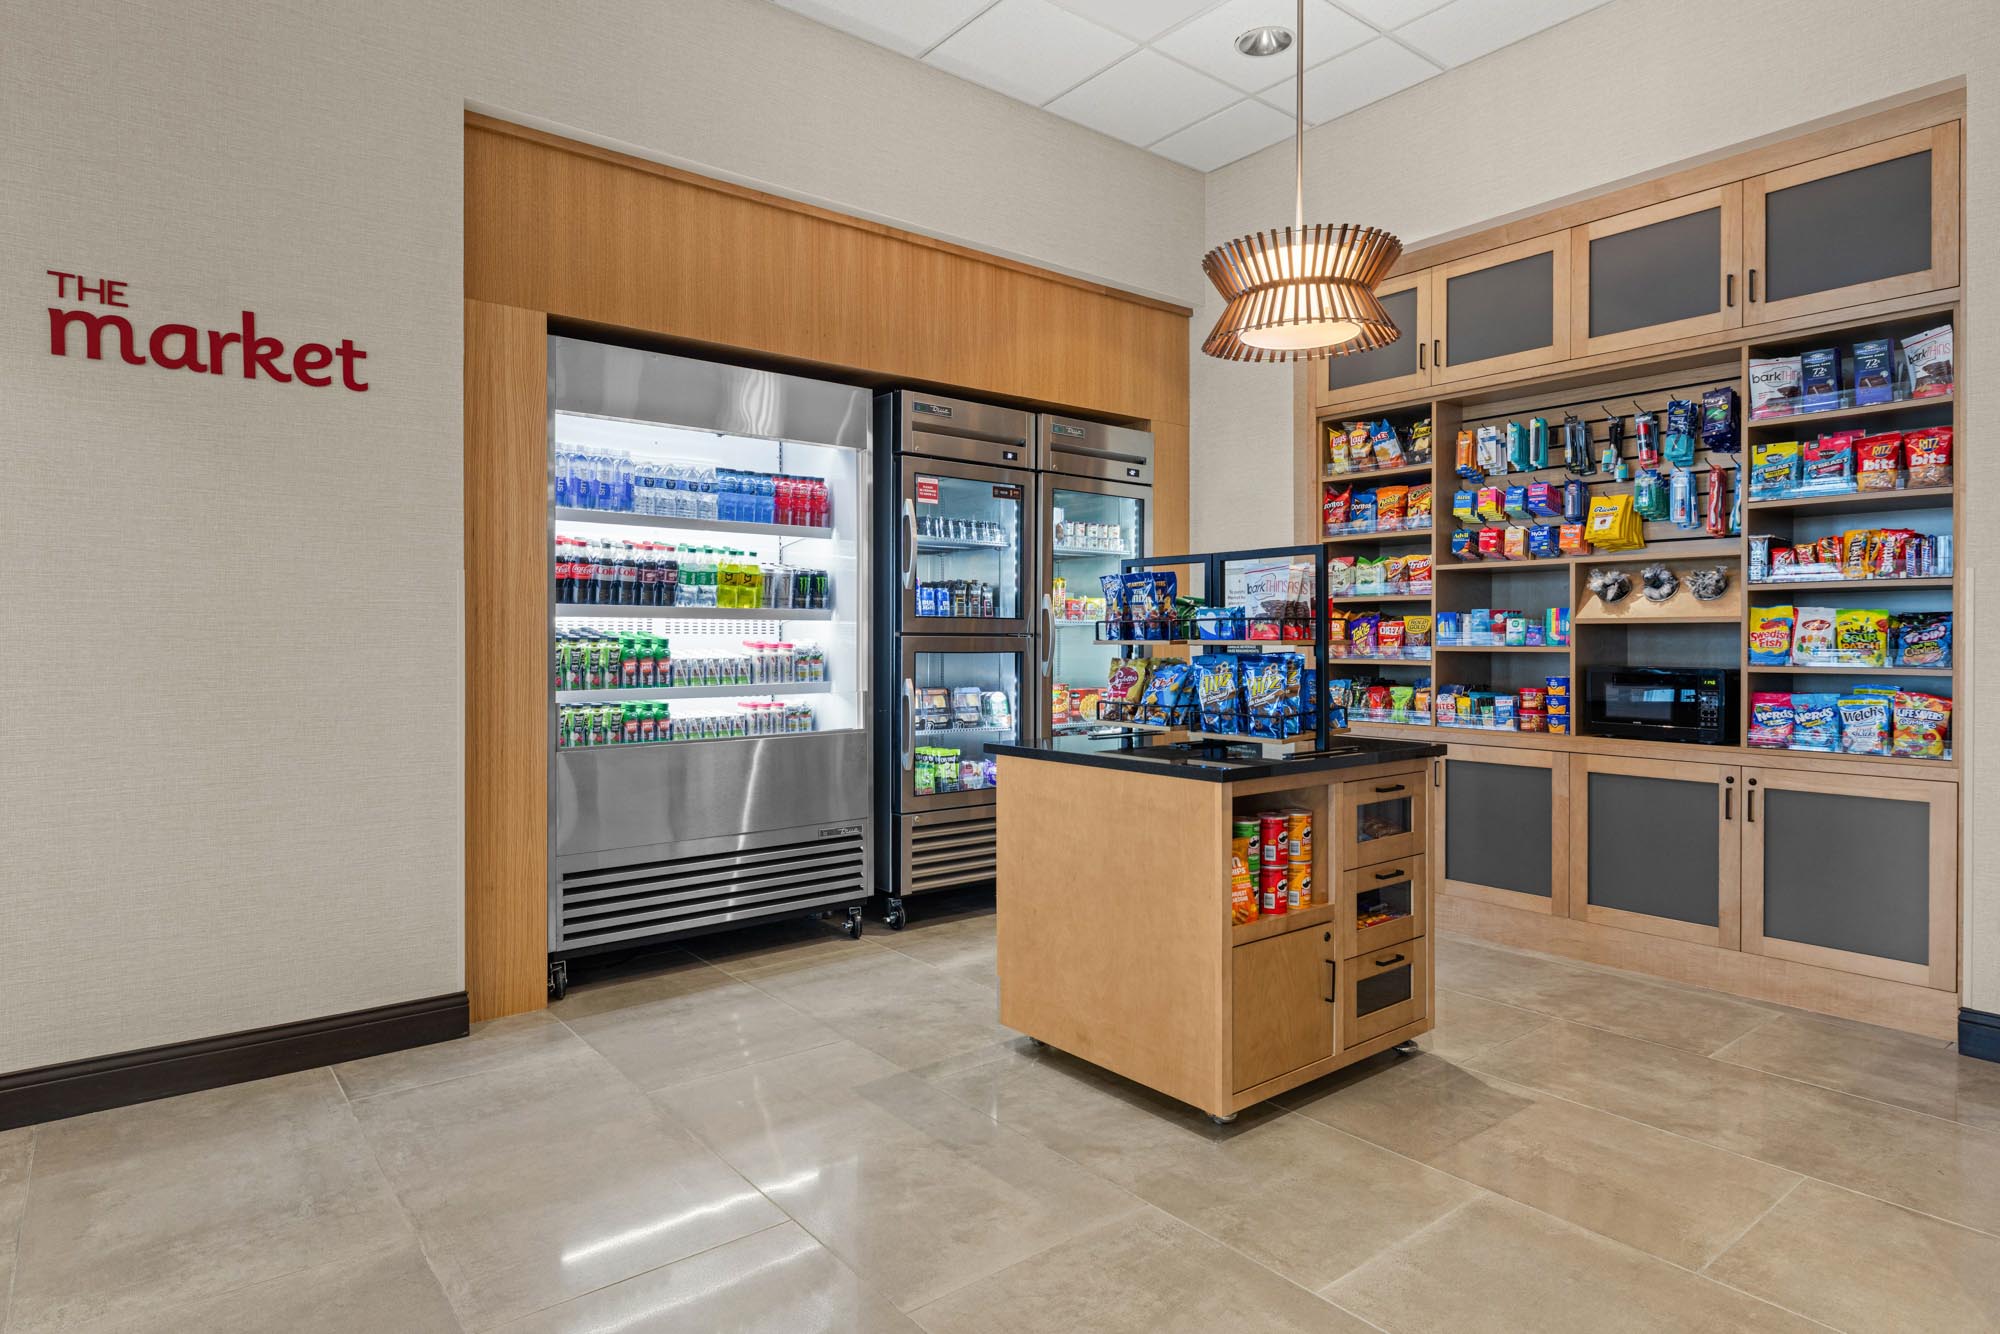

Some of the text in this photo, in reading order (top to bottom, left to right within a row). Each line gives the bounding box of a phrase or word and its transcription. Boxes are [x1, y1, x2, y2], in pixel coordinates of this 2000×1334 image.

[47, 270, 128, 308] THE
[48, 308, 369, 392] market
[1919, 438, 1940, 450] RITZ
[1872, 446, 1893, 457] RITZ
[1863, 459, 1896, 471] bits
[1911, 453, 1947, 466] bits
[1351, 502, 1372, 511] Doritos
[1246, 579, 1288, 595] barkTHINS
[1352, 623, 1371, 641] Takis
[1751, 630, 1790, 642] Swedish
[1842, 633, 1877, 643] SOUR
[1759, 639, 1783, 648] Fish
[1842, 642, 1880, 650] PATCH
[1843, 706, 1885, 722] Welch's
